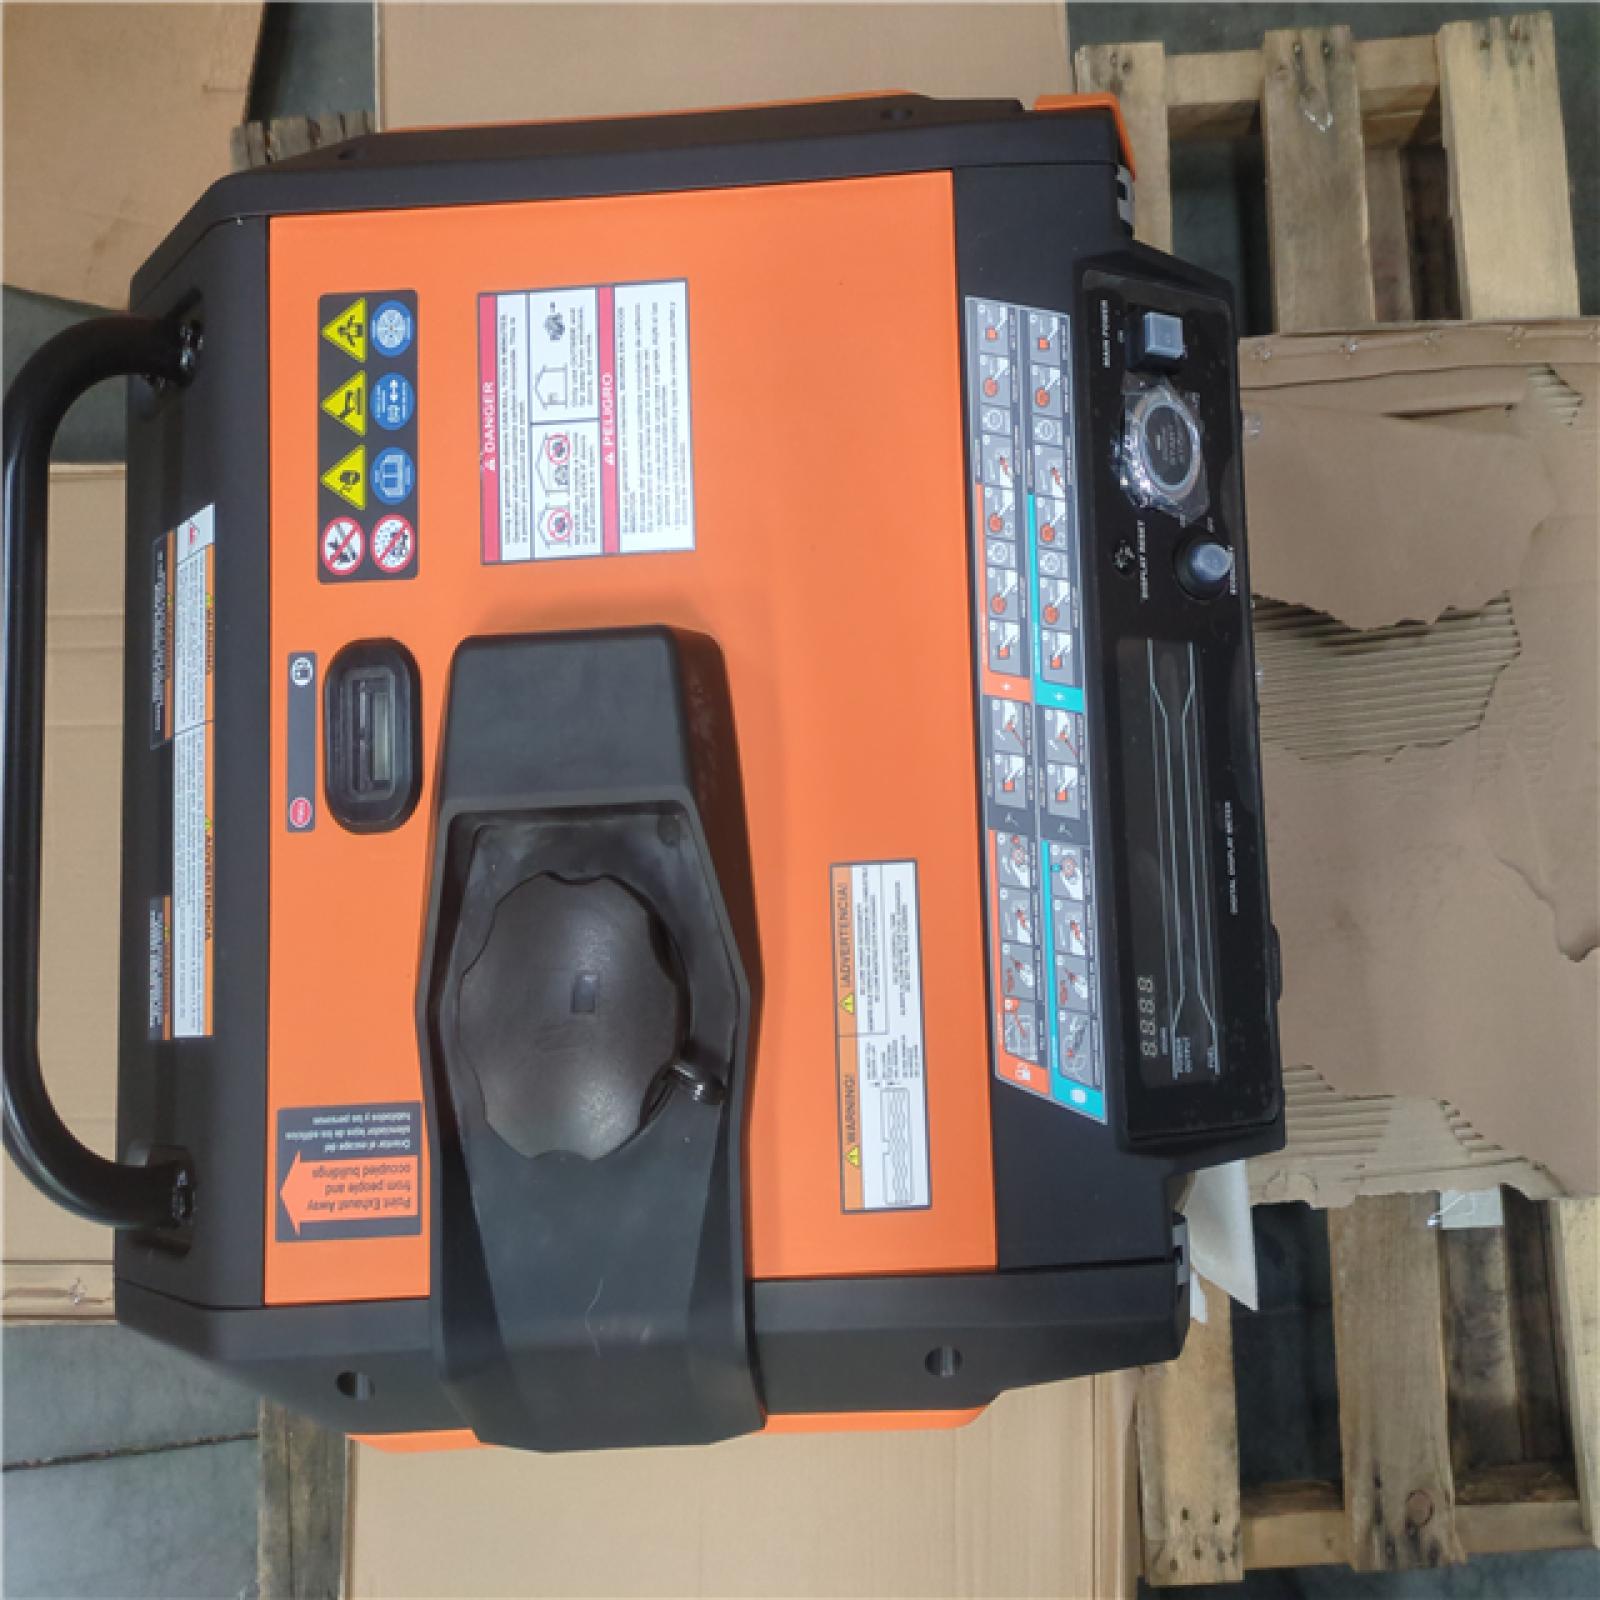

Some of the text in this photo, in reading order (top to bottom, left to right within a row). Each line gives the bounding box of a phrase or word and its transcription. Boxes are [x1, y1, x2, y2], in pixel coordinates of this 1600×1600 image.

[1100, 299, 1110, 338] POWER
[483, 381, 496, 453] DANGER
[602, 374, 614, 446] PELIGRO
[1137, 520, 1149, 600] DISPLAY RESET
[1224, 800, 1233, 834] METER
[1227, 837, 1236, 876] DISPLAY
[837, 883, 851, 988] ¡ADVERTENCIA!
[845, 1073, 857, 1144] WARNING!
[312, 1163, 411, 1178] occupied buildings
[325, 1179, 411, 1195] from people and
[308, 1198, 411, 1211] Point Exhaust Away
